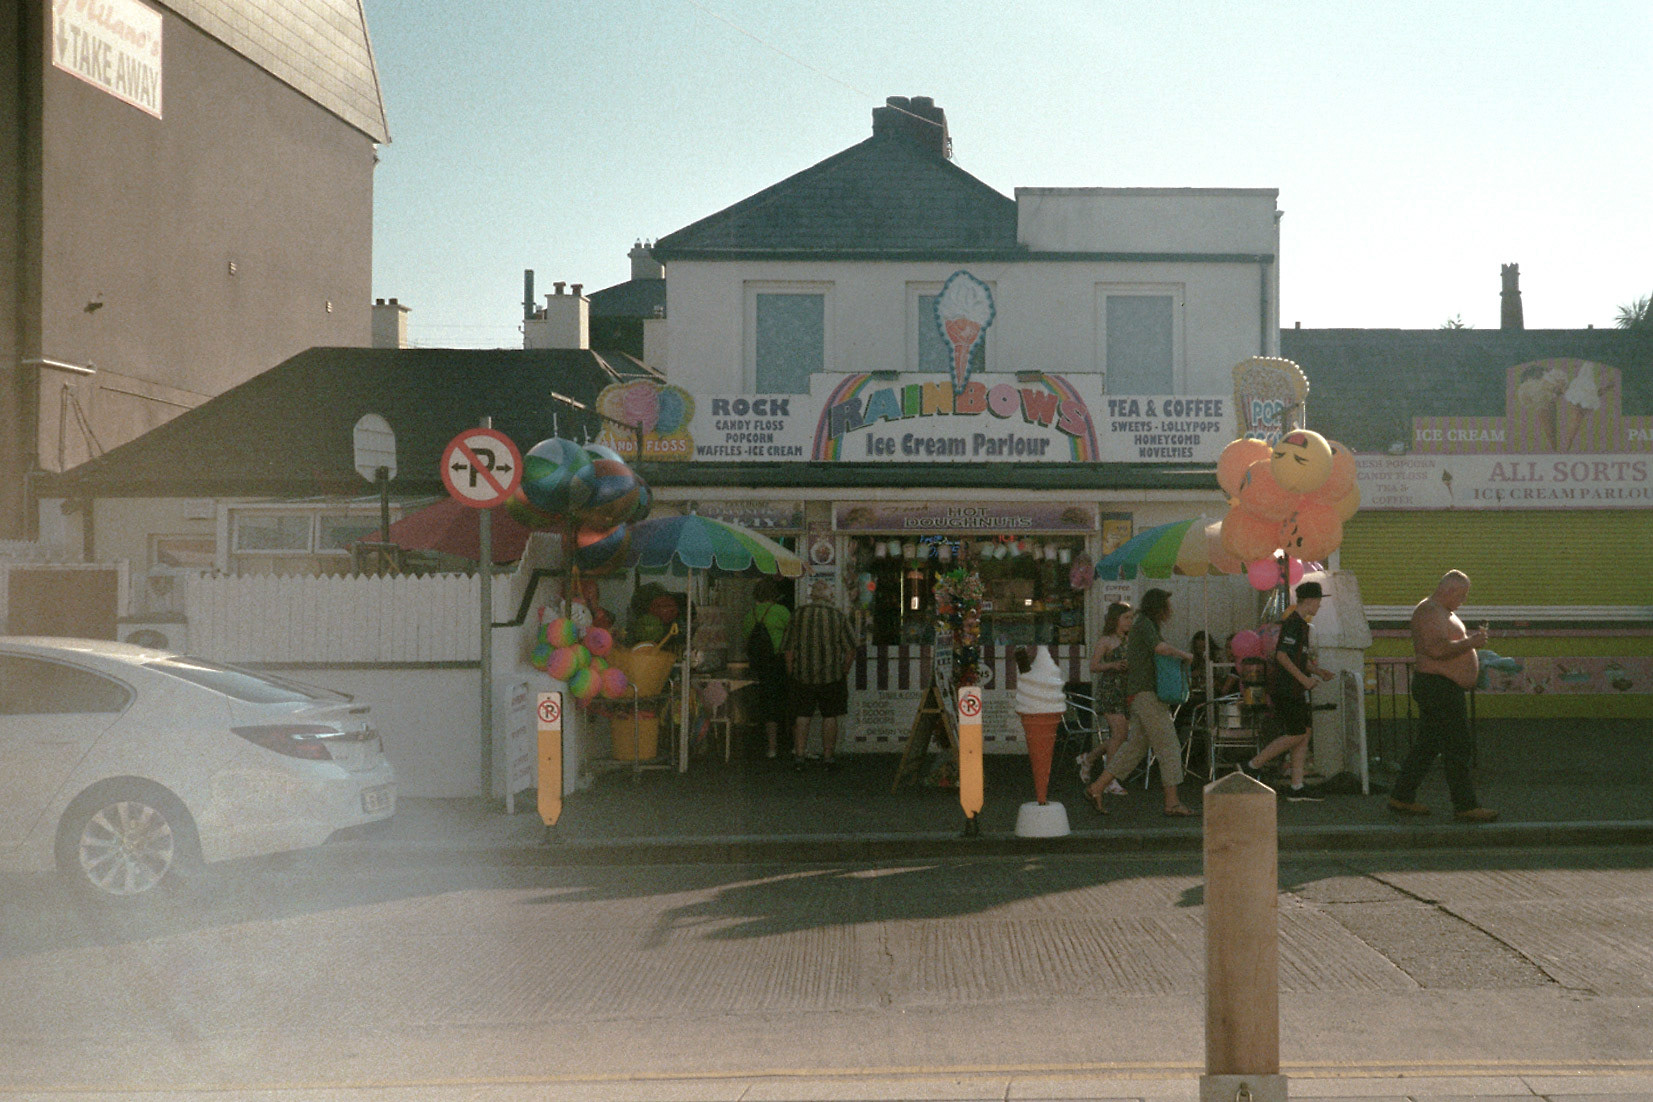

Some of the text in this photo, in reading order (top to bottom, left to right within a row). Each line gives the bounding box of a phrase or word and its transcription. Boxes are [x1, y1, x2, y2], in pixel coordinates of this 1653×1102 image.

[70, 24, 159, 109] TAKE AWAY
[711, 398, 790, 416] ROCK
[829, 381, 1089, 441] RAINBOWS
[1108, 399, 1223, 417] TEA & COFFEE
[1252, 399, 1285, 426] POP
[715, 420, 784, 431] CANDY FLOSS
[1111, 421, 1152, 432] SWEETS
[1161, 421, 1220, 432] LOLLYPOPS
[726, 432, 774, 443] POPCORN
[1134, 434, 1201, 445] HONEYCOMB
[1416, 429, 1443, 441] ICE
[1447, 429, 1506, 441] CREAM
[647, 439, 686, 452] FLOSS
[866, 432, 1051, 456] Ice Cream Parlour
[696, 445, 742, 456] WAFFLES
[767, 445, 803, 456] CREAM
[1139, 446, 1194, 458] NOVELTIES
[1354, 459, 1436, 468] RESH POPCORN
[1356, 471, 1428, 481] CANDY FLOSS
[1488, 461, 1648, 482] ALL SORTS
[1376, 484, 1398, 492] TEA
[1371, 495, 1414, 504] COFFEE
[1473, 488, 1505, 500] ICE
[1509, 488, 1575, 500] CREAM
[948, 507, 988, 517] HOT
[904, 517, 1032, 528] DOUGHNUTS
